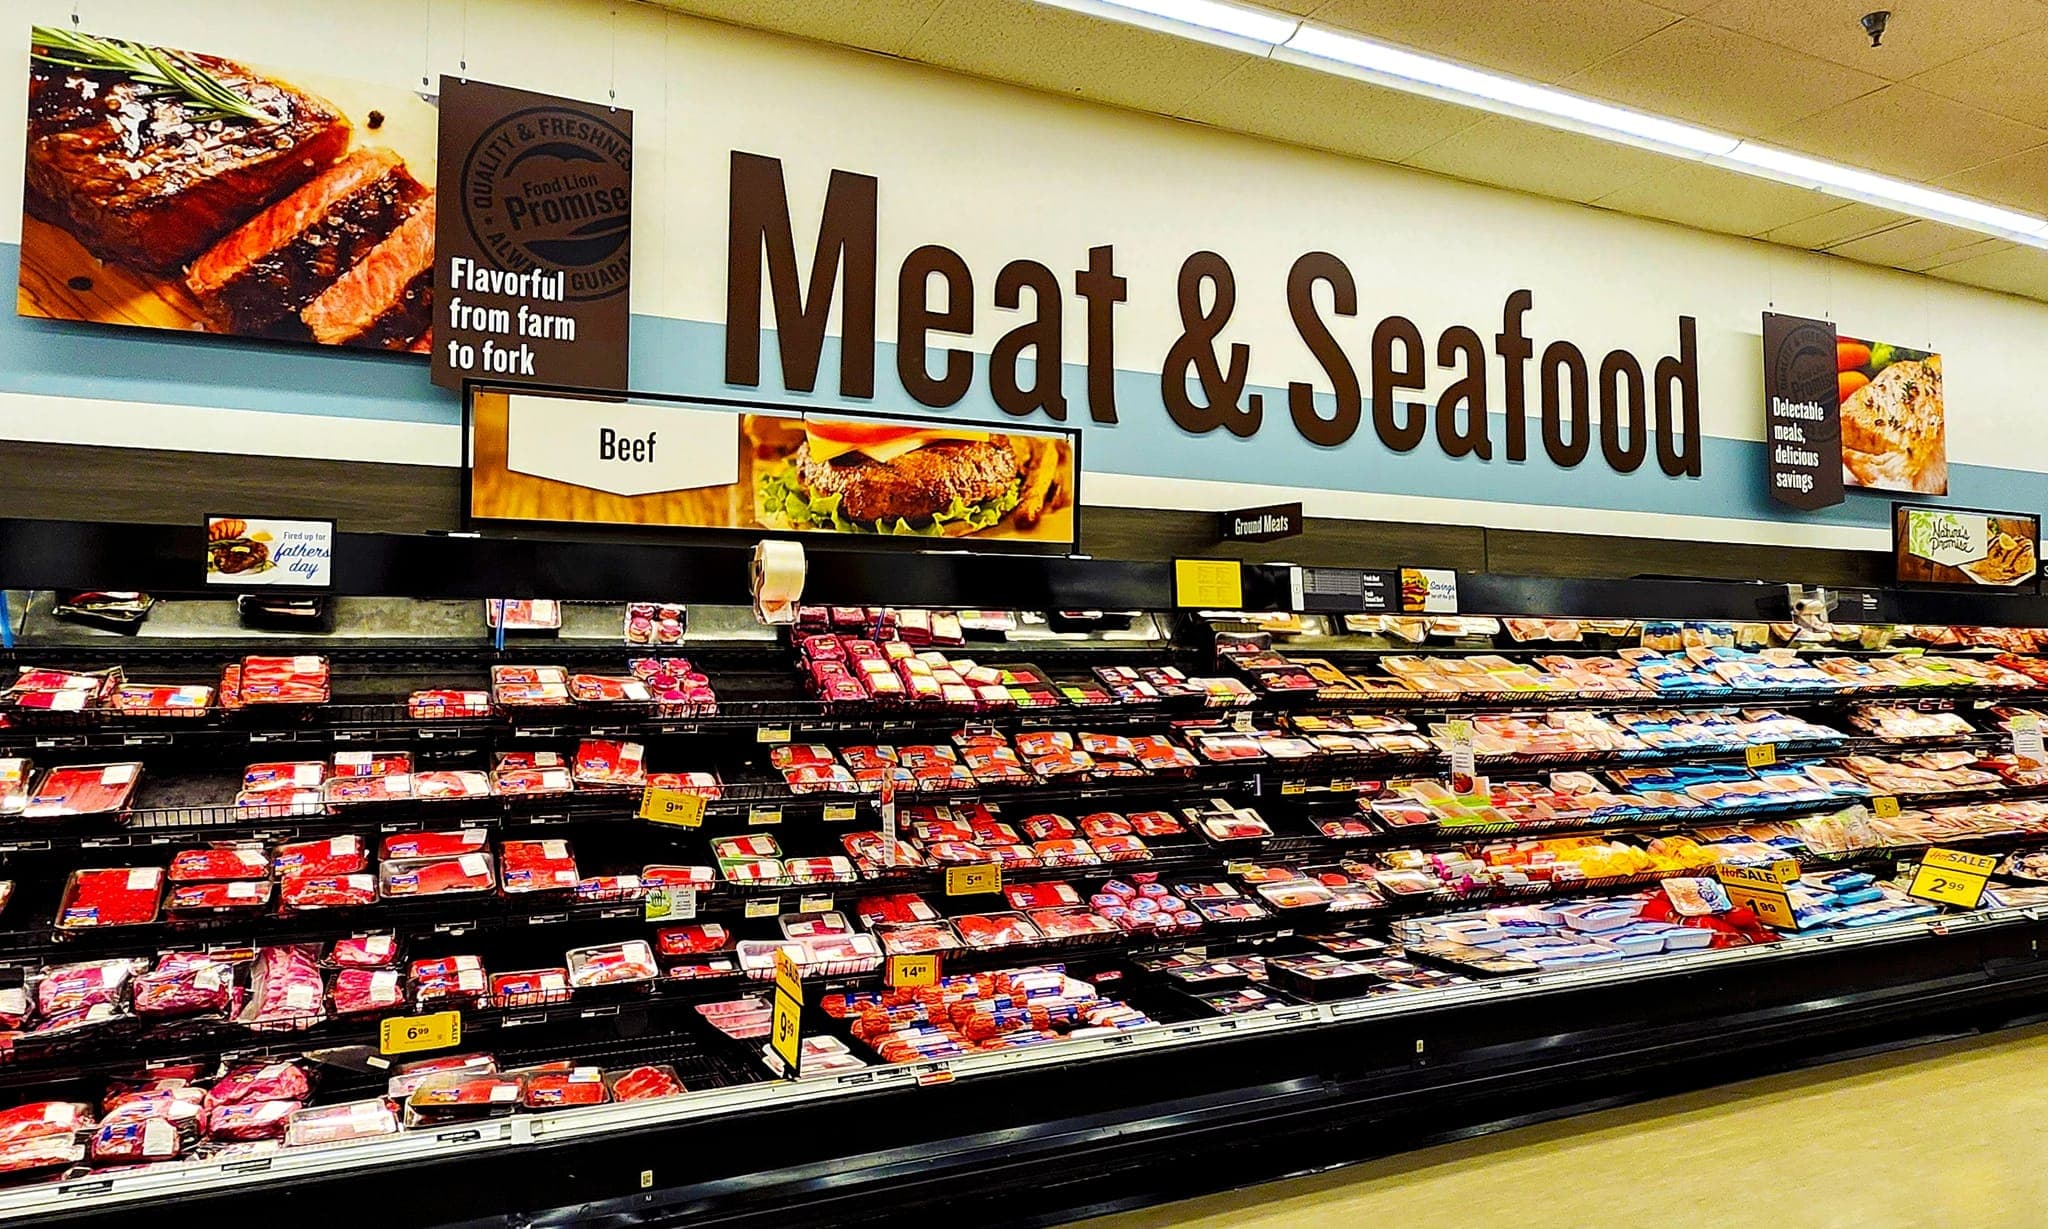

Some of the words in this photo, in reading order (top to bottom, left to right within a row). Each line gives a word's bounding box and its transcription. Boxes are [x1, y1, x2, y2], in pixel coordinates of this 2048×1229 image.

[473, 132, 514, 208] QUALITY
[517, 123, 535, 140] &
[522, 179, 562, 198] Food
[565, 174, 598, 191] Lion
[505, 186, 630, 231] Promise
[451, 257, 564, 301] Flavorful
[450, 298, 509, 334] from
[517, 305, 575, 341] farm
[725, 150, 1127, 424] Meat
[1161, 250, 1263, 440] &
[1287, 251, 1702, 478] Seafood
[448, 340, 474, 369] to
[483, 341, 535, 375] fork
[1773, 397, 1824, 421] Delectable
[1774, 423, 1806, 444] meals,
[600, 427, 656, 464] Beef
[1775, 444, 1819, 467] delicious
[1776, 471, 1813, 493] savings
[283, 531, 302, 540] Fired
[304, 533, 314, 541] up
[315, 531, 326, 540] for
[1235, 516, 1262, 535] Ground
[1263, 515, 1288, 532] Meats
[1933, 518, 1970, 540] Nature's
[274, 543, 331, 562] fathers
[1929, 537, 1975, 556] Promise
[289, 558, 318, 579] day
